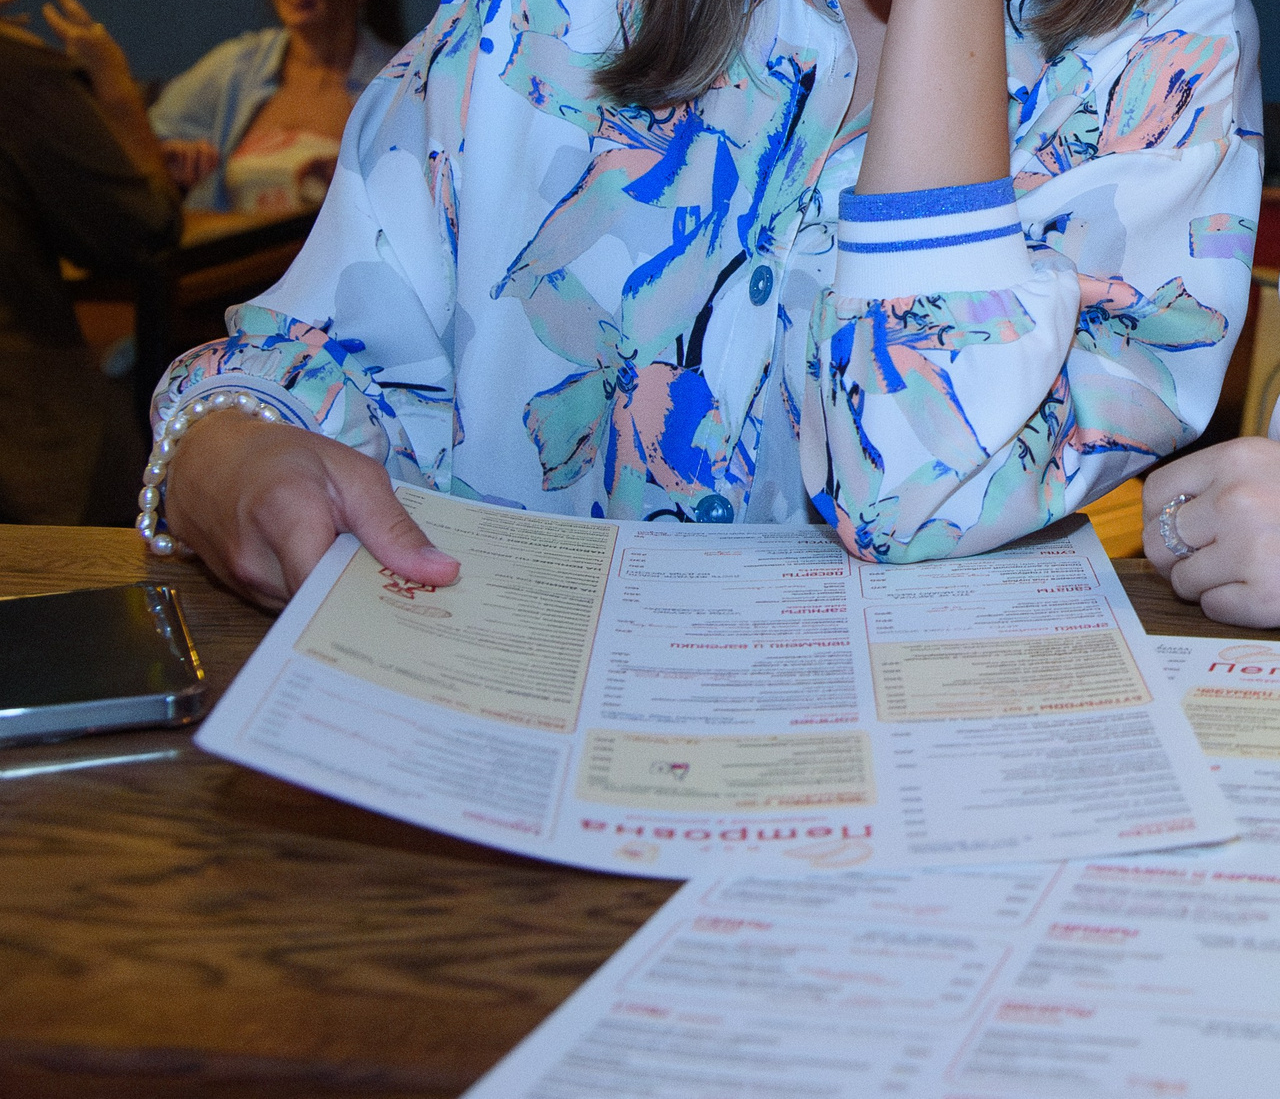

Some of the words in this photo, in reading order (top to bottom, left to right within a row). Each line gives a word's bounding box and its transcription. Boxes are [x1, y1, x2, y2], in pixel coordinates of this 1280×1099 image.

[782, 570, 845, 578] десерты
[1036, 585, 1092, 594] салаты
[781, 607, 847, 615] гарниры
[1054, 622, 1109, 632] гренки
[770, 641, 850, 649] пельмени
[580, 818, 872, 841] Петровна
